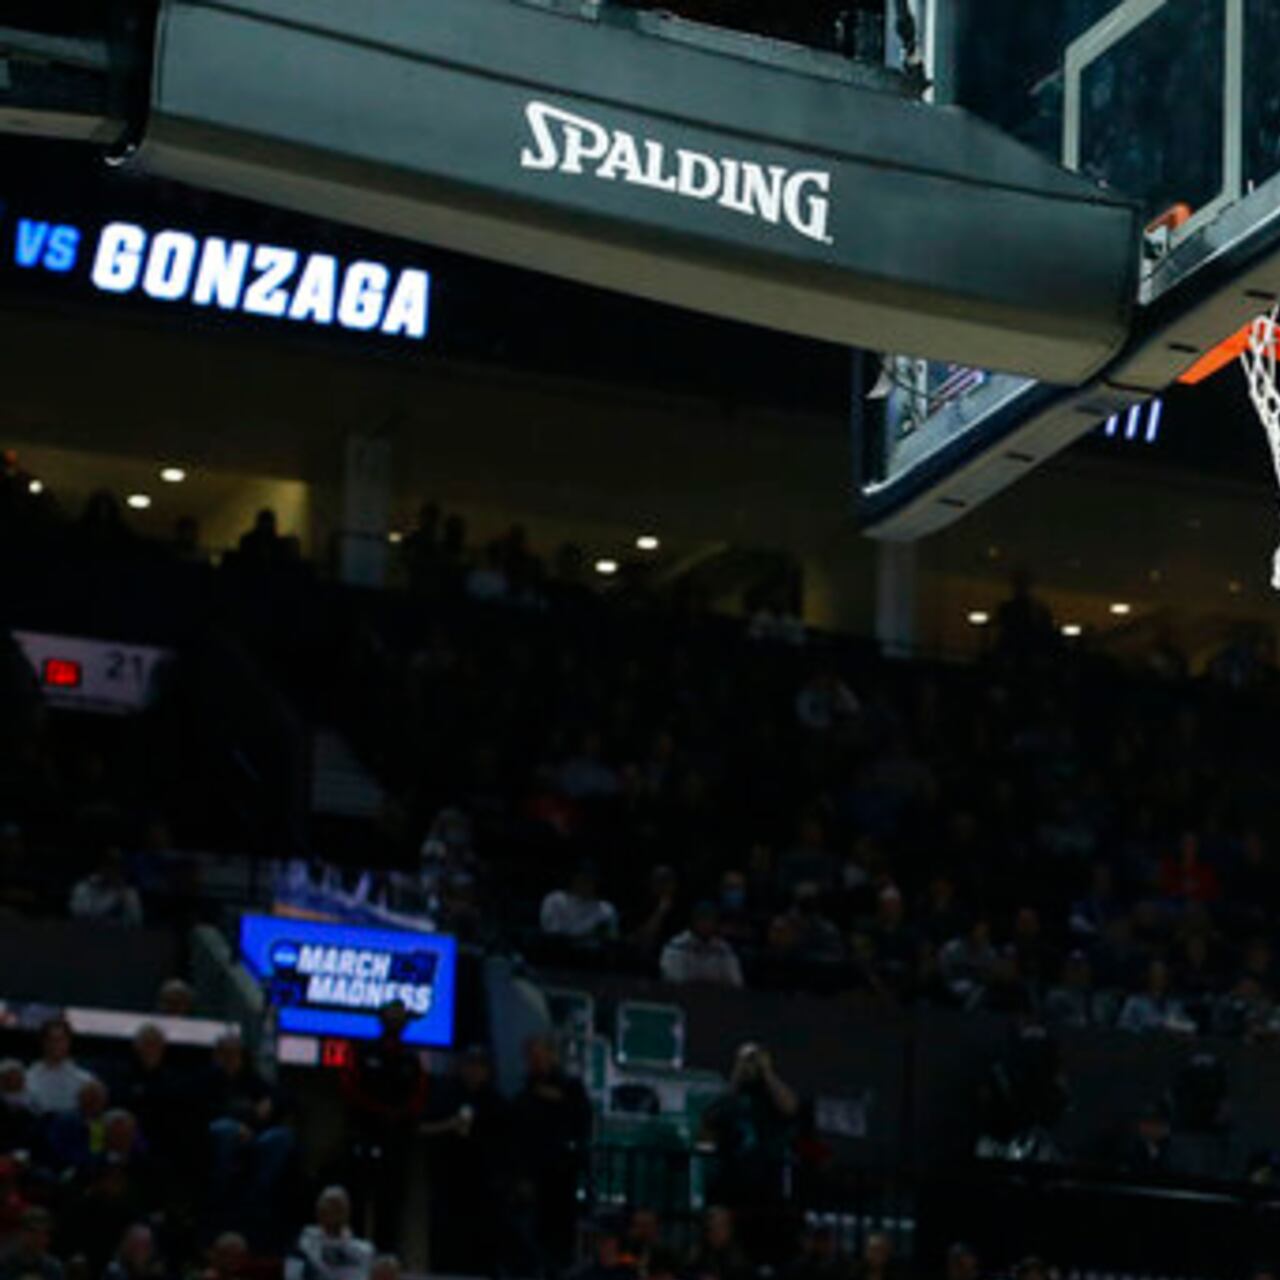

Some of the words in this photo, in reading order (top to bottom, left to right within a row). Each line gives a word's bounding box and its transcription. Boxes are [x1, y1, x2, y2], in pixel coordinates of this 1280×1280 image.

[520, 100, 831, 244] SPALDING
[14, 218, 81, 273] VS
[91, 221, 431, 339] GONZAGA
[297, 945, 392, 979] MARCH
